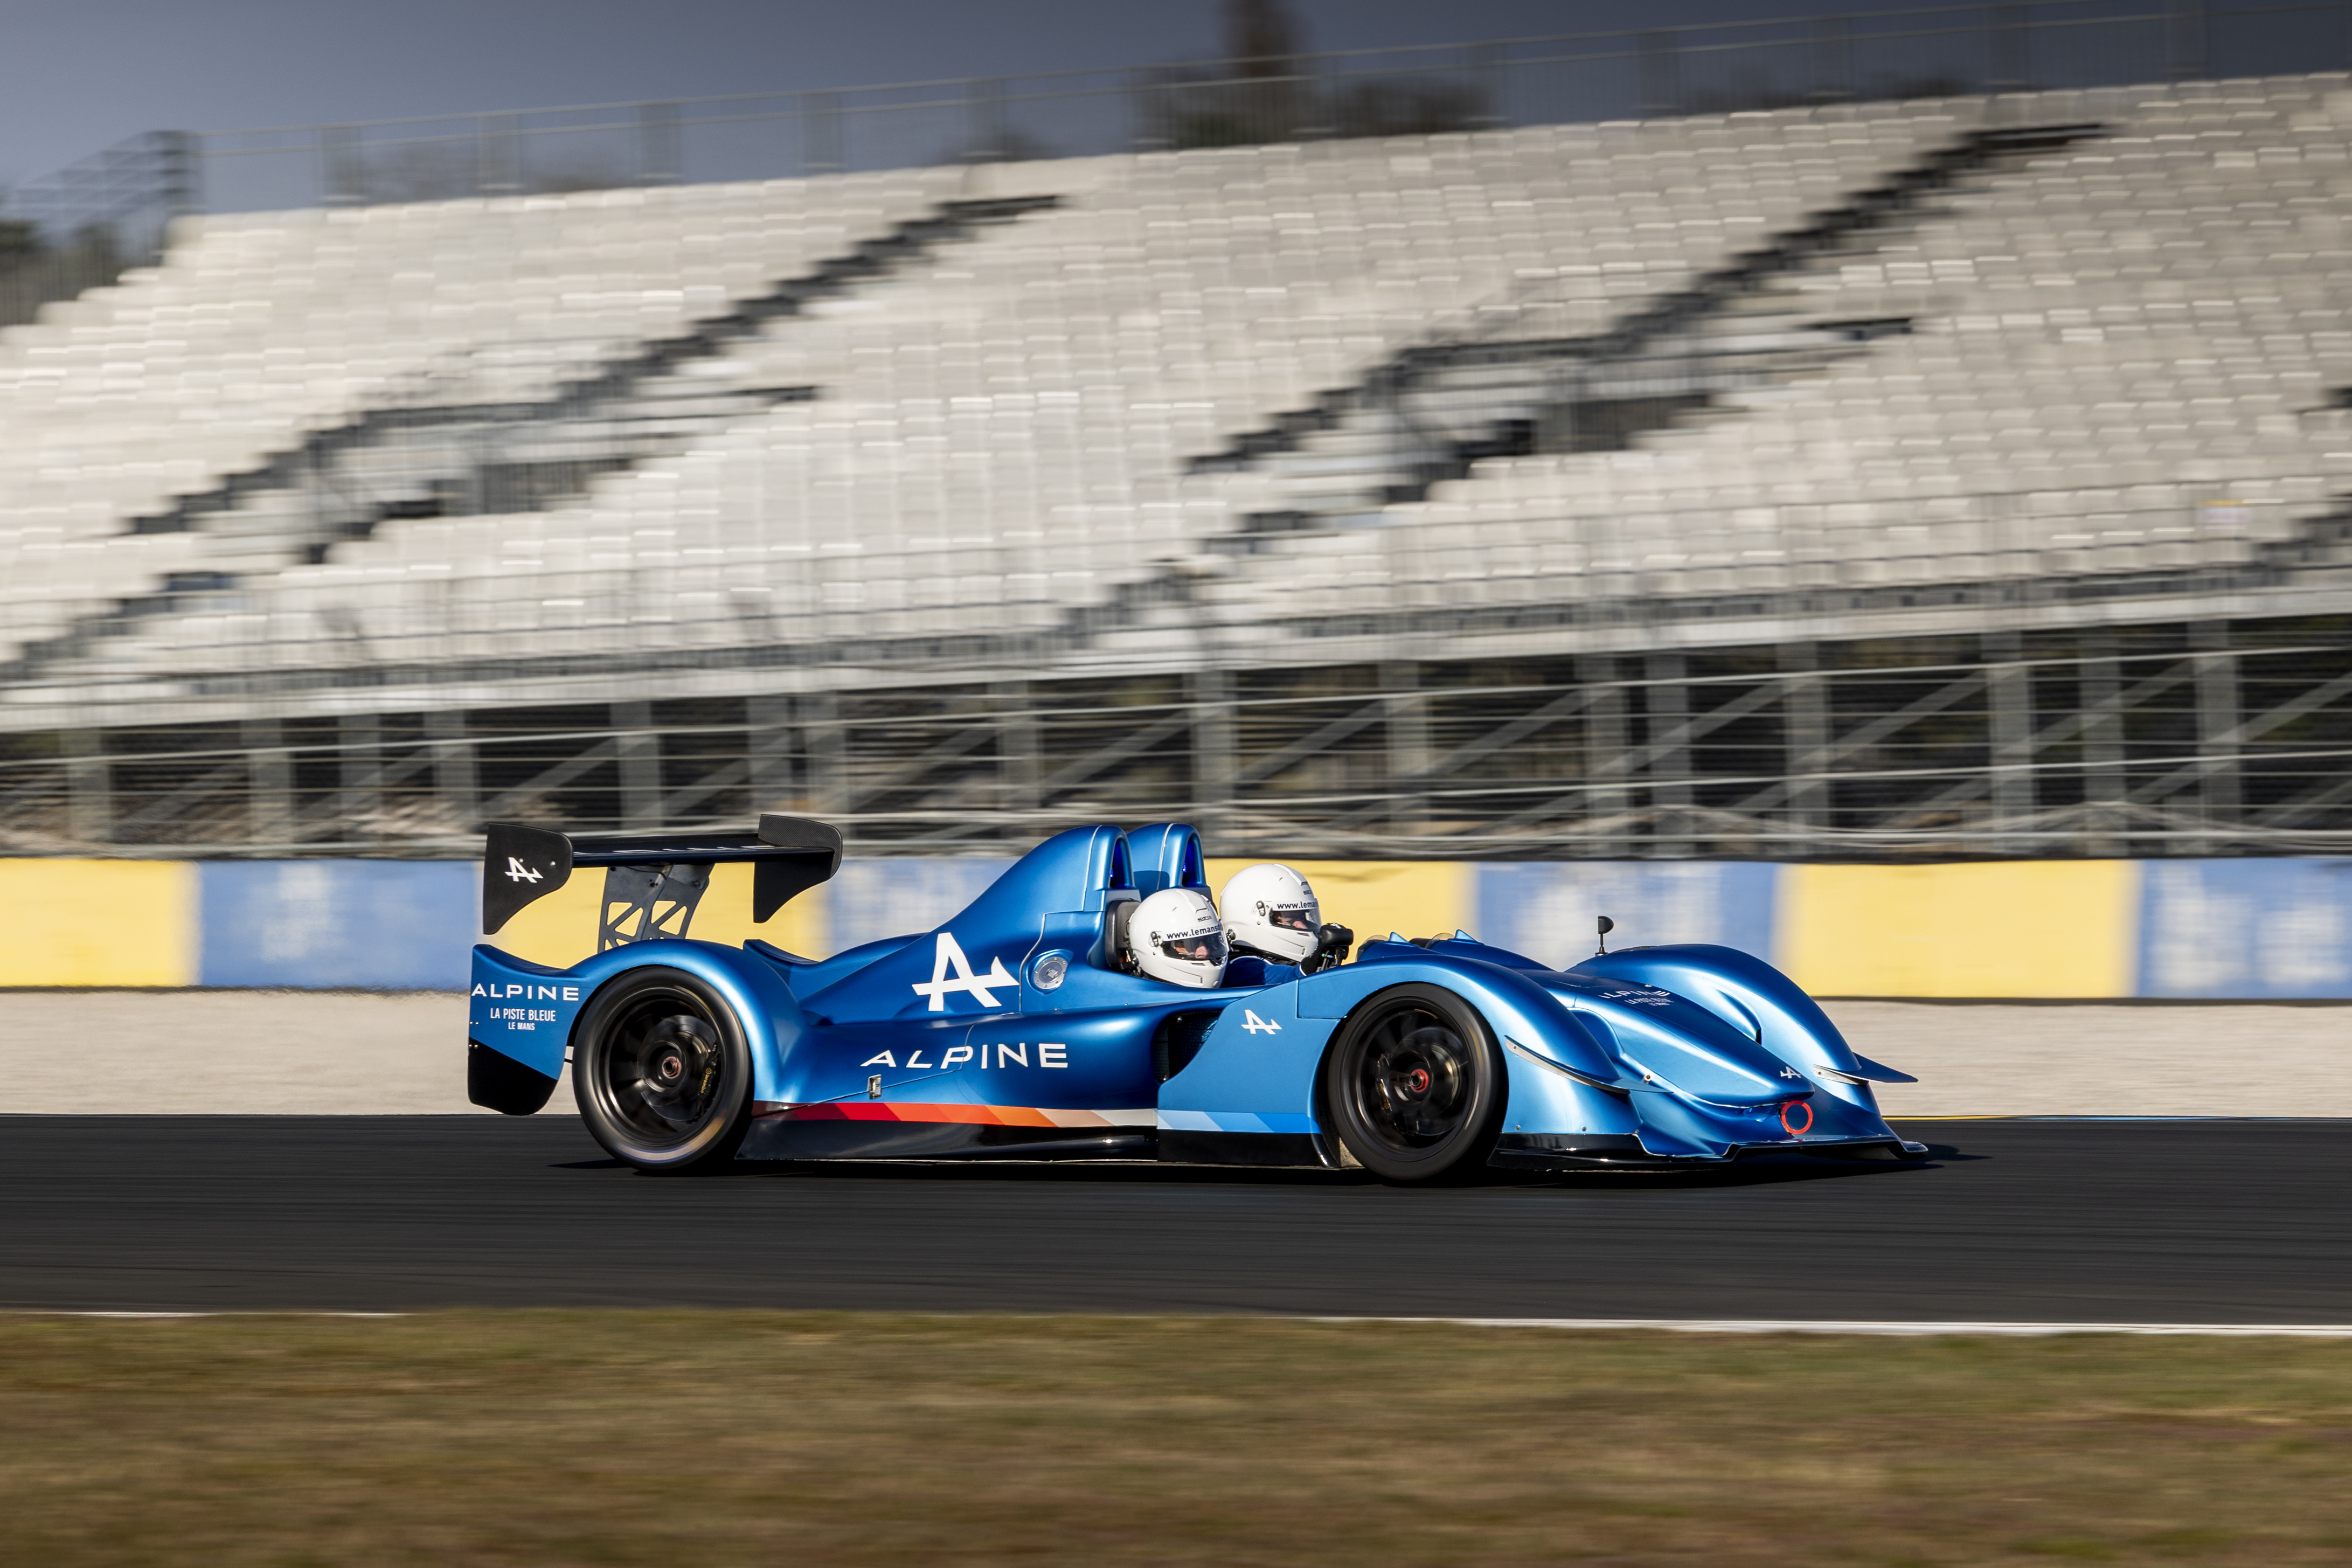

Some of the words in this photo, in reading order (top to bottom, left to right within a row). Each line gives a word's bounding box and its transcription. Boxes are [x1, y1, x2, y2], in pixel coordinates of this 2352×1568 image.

[471, 983, 579, 1001] ALPINE
[490, 1008, 501, 1019] LA
[503, 1008, 525, 1020] PISTE
[528, 1009, 556, 1022] BLEUE
[508, 1022, 516, 1030] LE
[517, 1022, 535, 1031] MANS
[860, 1043, 1068, 1069] ALPINE
